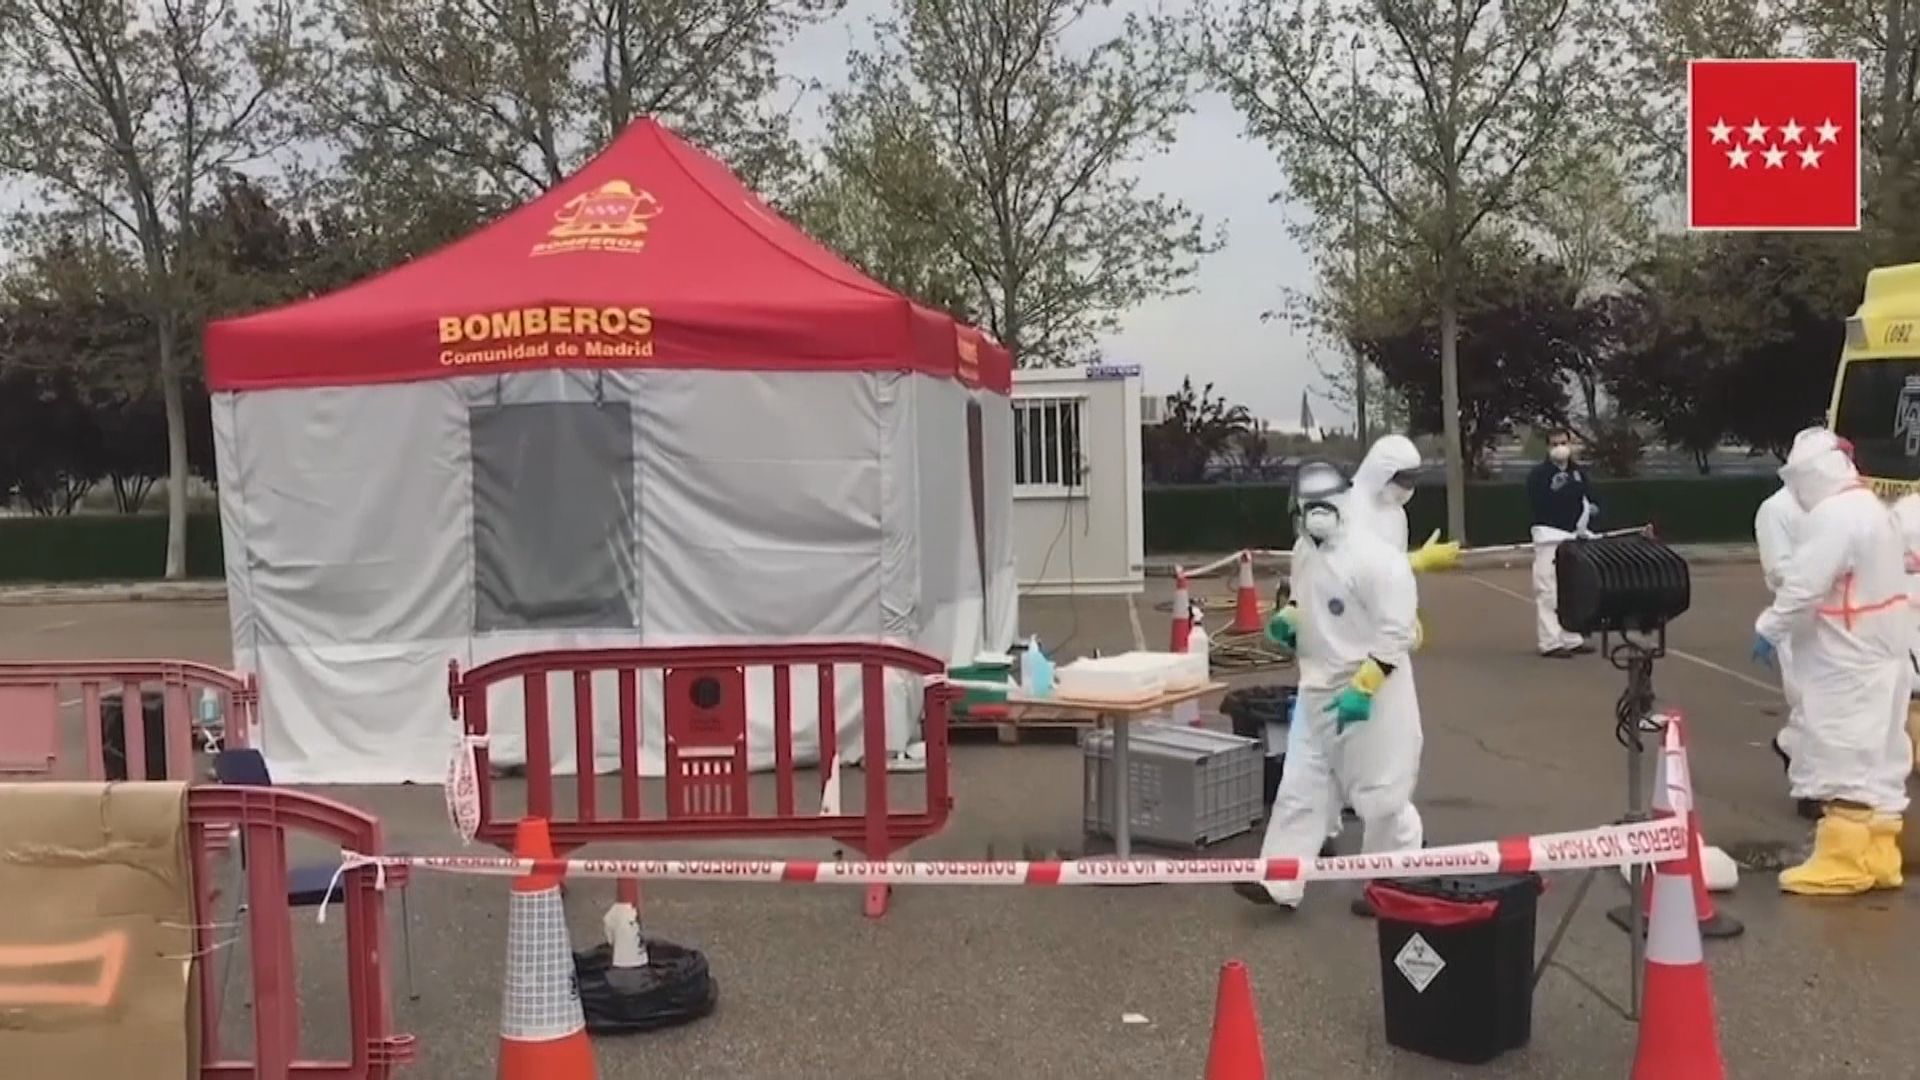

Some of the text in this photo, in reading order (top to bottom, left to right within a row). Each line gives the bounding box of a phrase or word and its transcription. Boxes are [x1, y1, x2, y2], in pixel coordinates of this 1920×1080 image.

[438, 306, 653, 343] BOMBEROS
[439, 341, 653, 366] Comunidad de Madrid
[1547, 838, 1597, 860] PASAR
[1599, 835, 1622, 857] NO
[1371, 856, 1393, 870] NO
[1402, 850, 1490, 868] BOMBEROS
